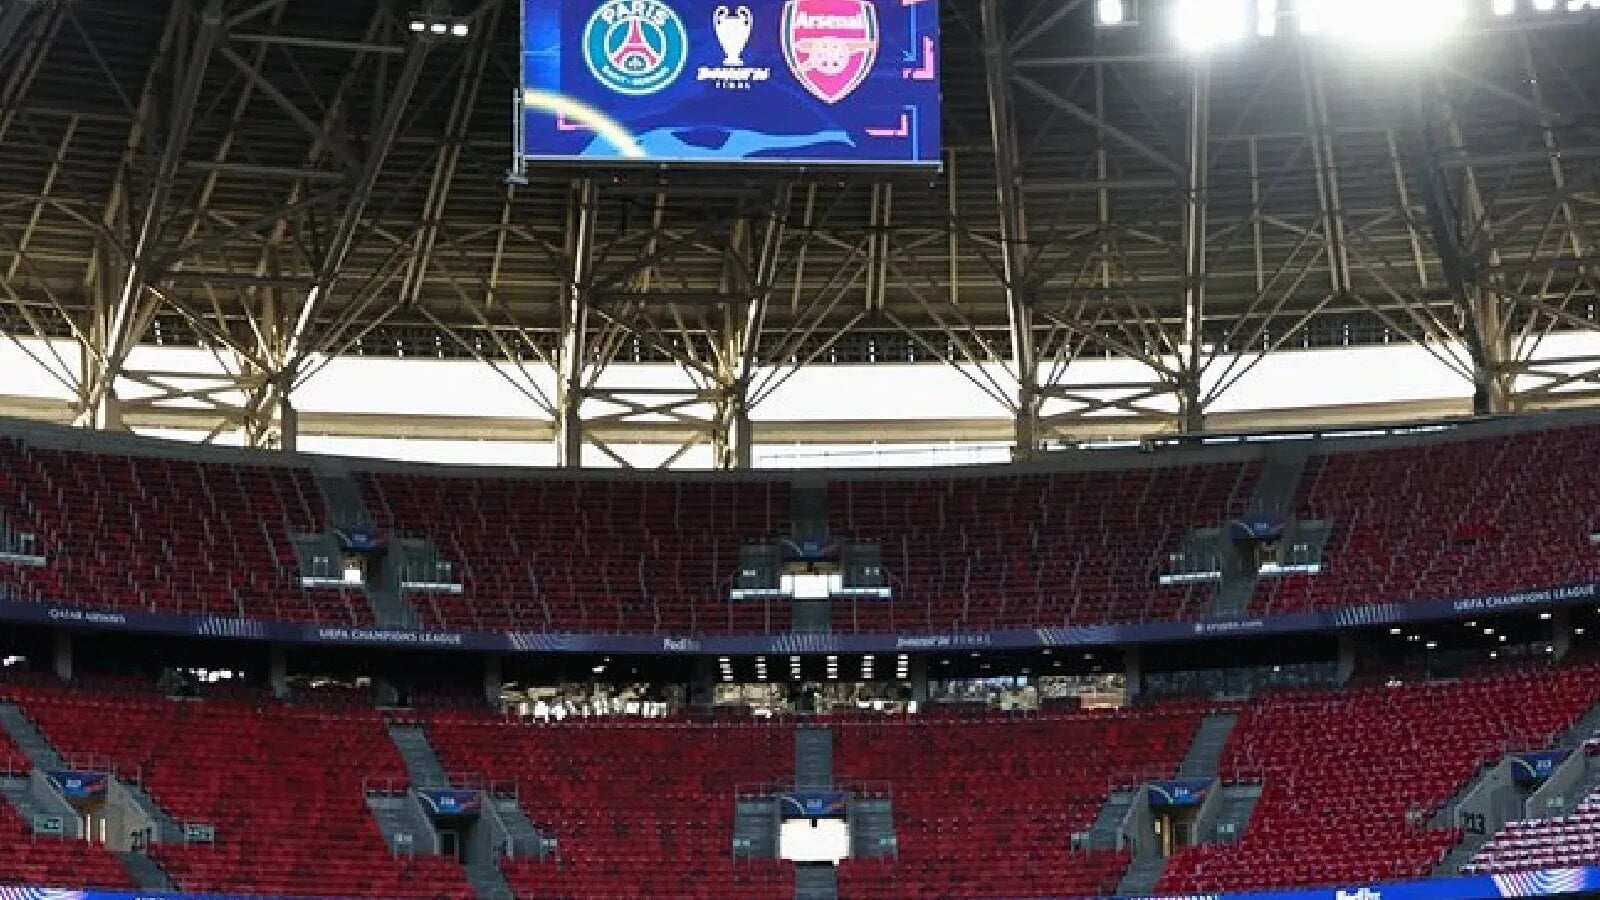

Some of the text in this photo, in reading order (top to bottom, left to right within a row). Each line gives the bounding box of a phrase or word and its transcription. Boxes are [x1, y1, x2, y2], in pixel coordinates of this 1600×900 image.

[601, 1, 670, 26] PARIS
[796, 11, 864, 29] Arsenal
[1453, 598, 1484, 610] UEFA
[1553, 583, 1595, 599] LEAGUE
